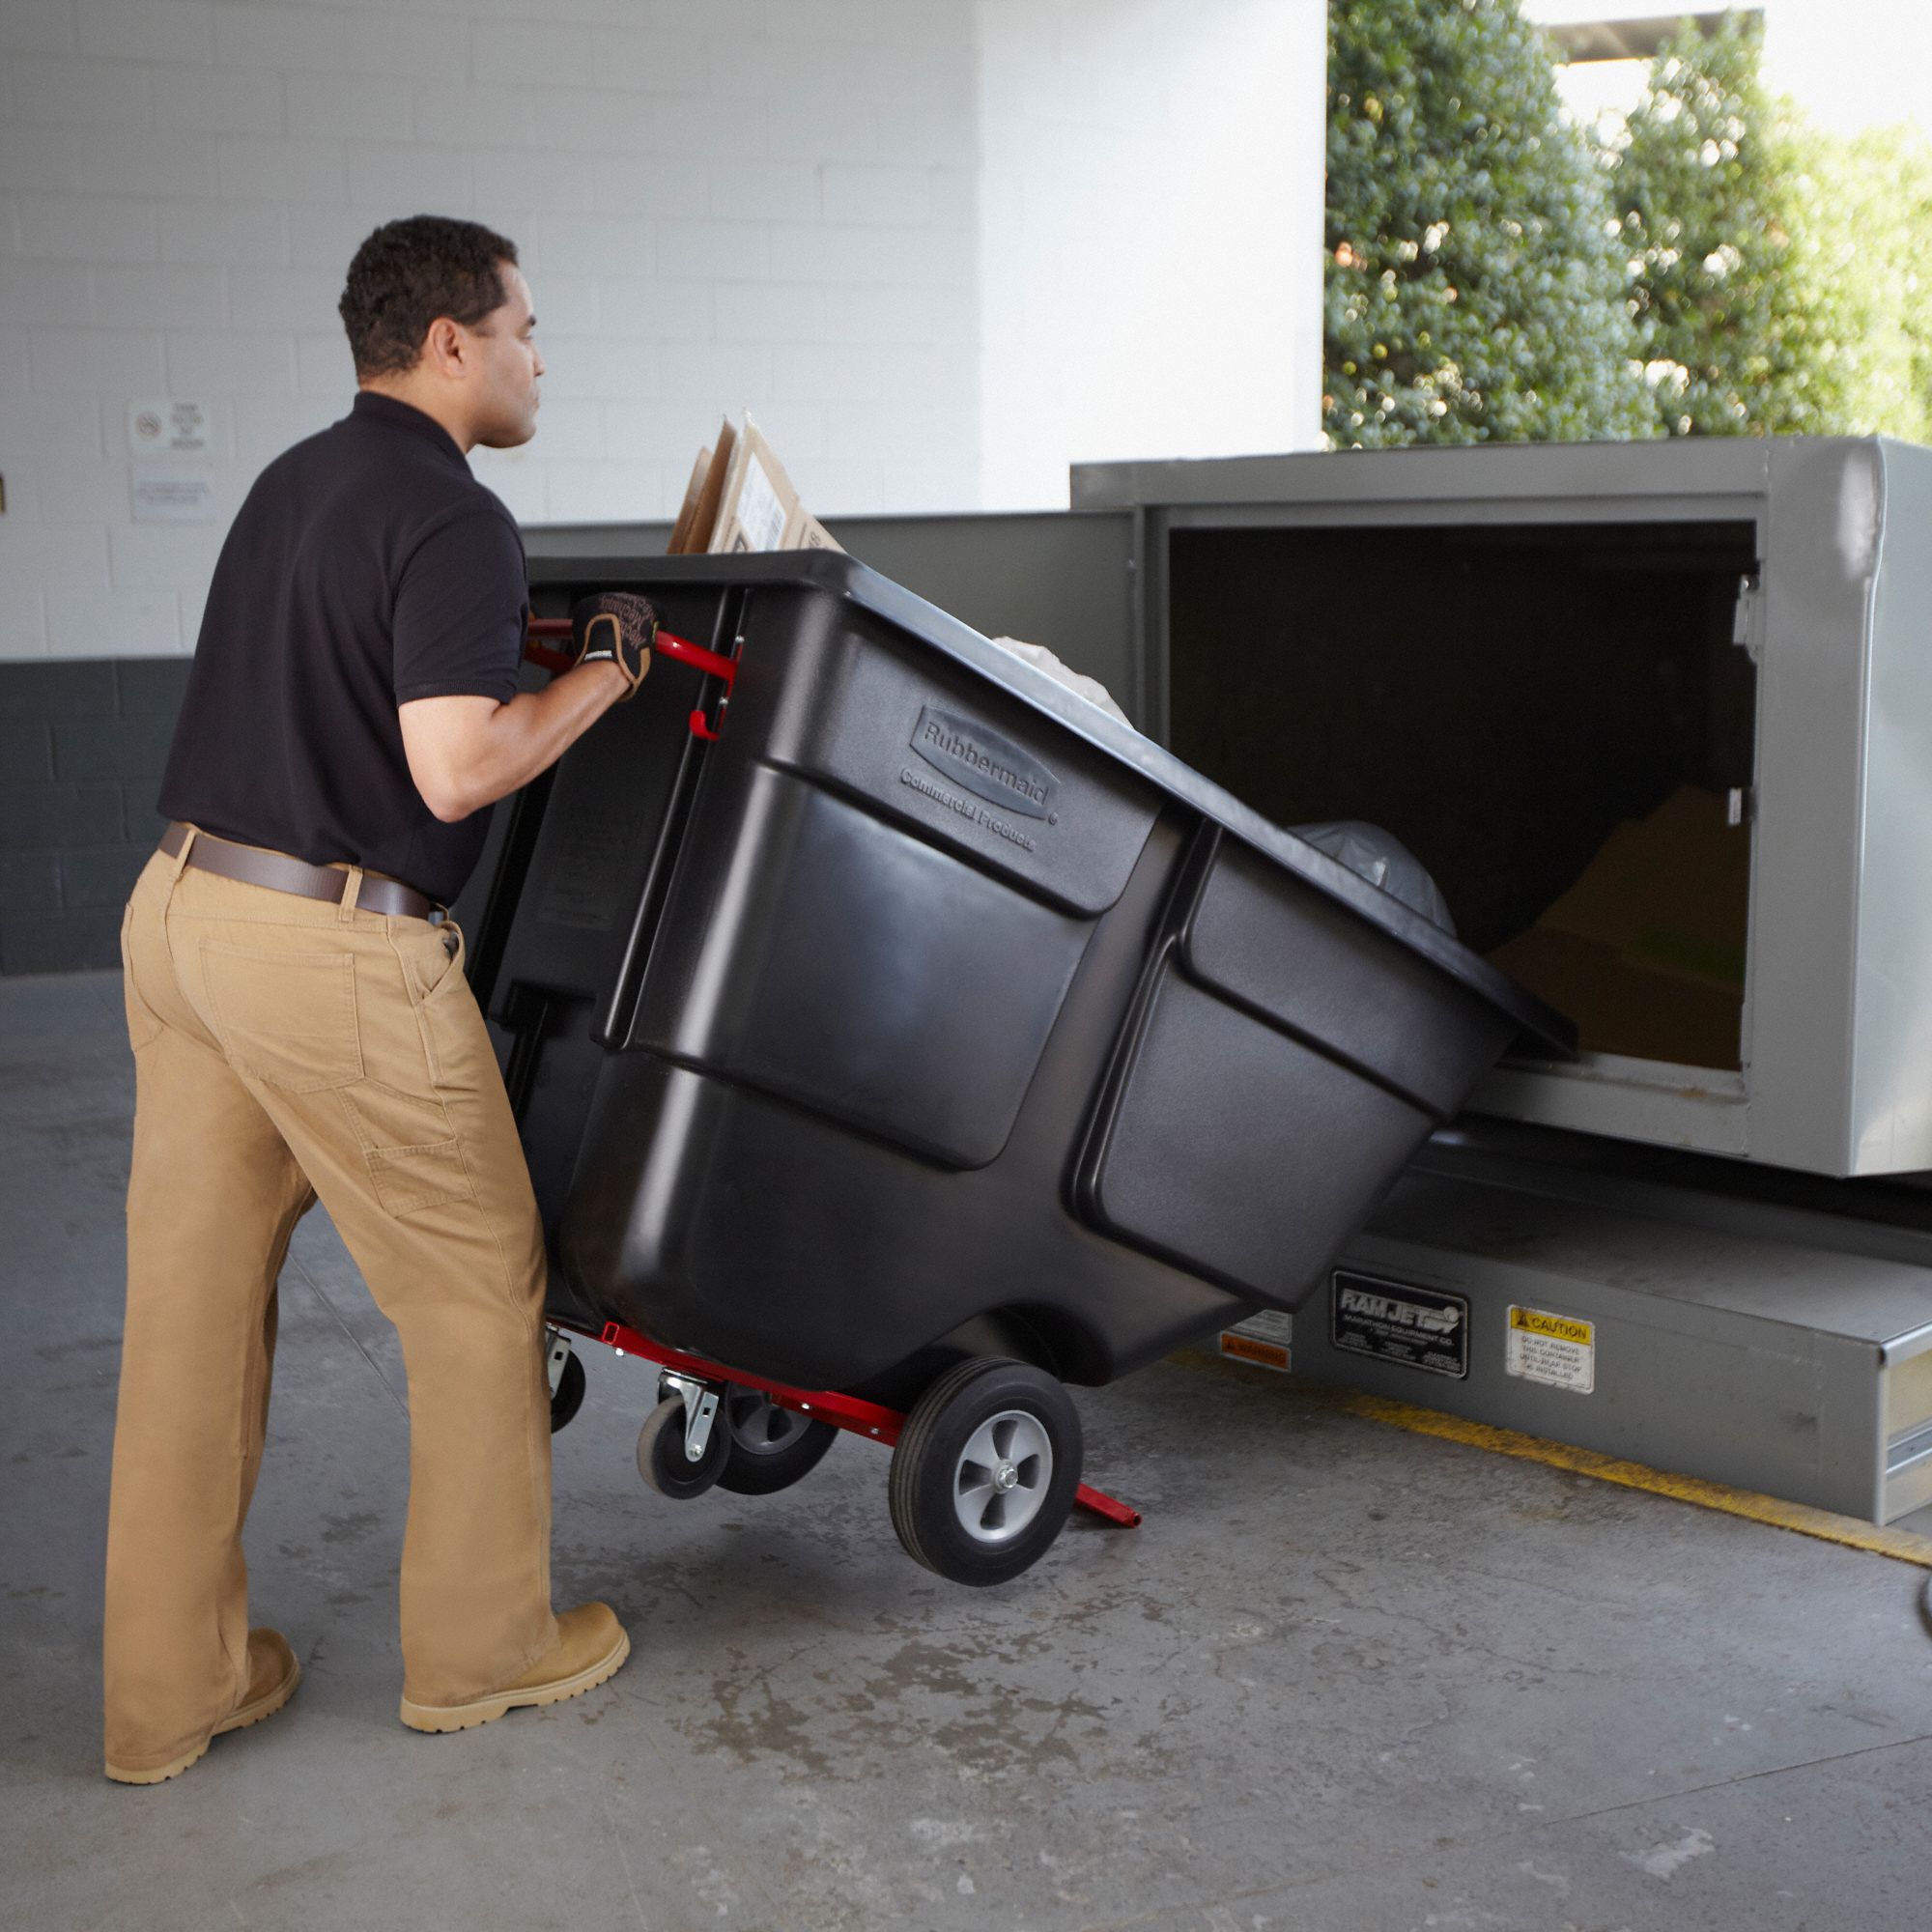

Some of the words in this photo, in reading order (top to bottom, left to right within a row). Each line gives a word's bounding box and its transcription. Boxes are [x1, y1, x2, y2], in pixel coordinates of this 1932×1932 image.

[924, 722, 1049, 805] Rubbermaid
[900, 767, 977, 820] Commercial
[978, 810, 1037, 852] Products
[1391, 1322, 1438, 1343] EQUIPMENT
[1531, 1318, 1586, 1339] CAUTION
